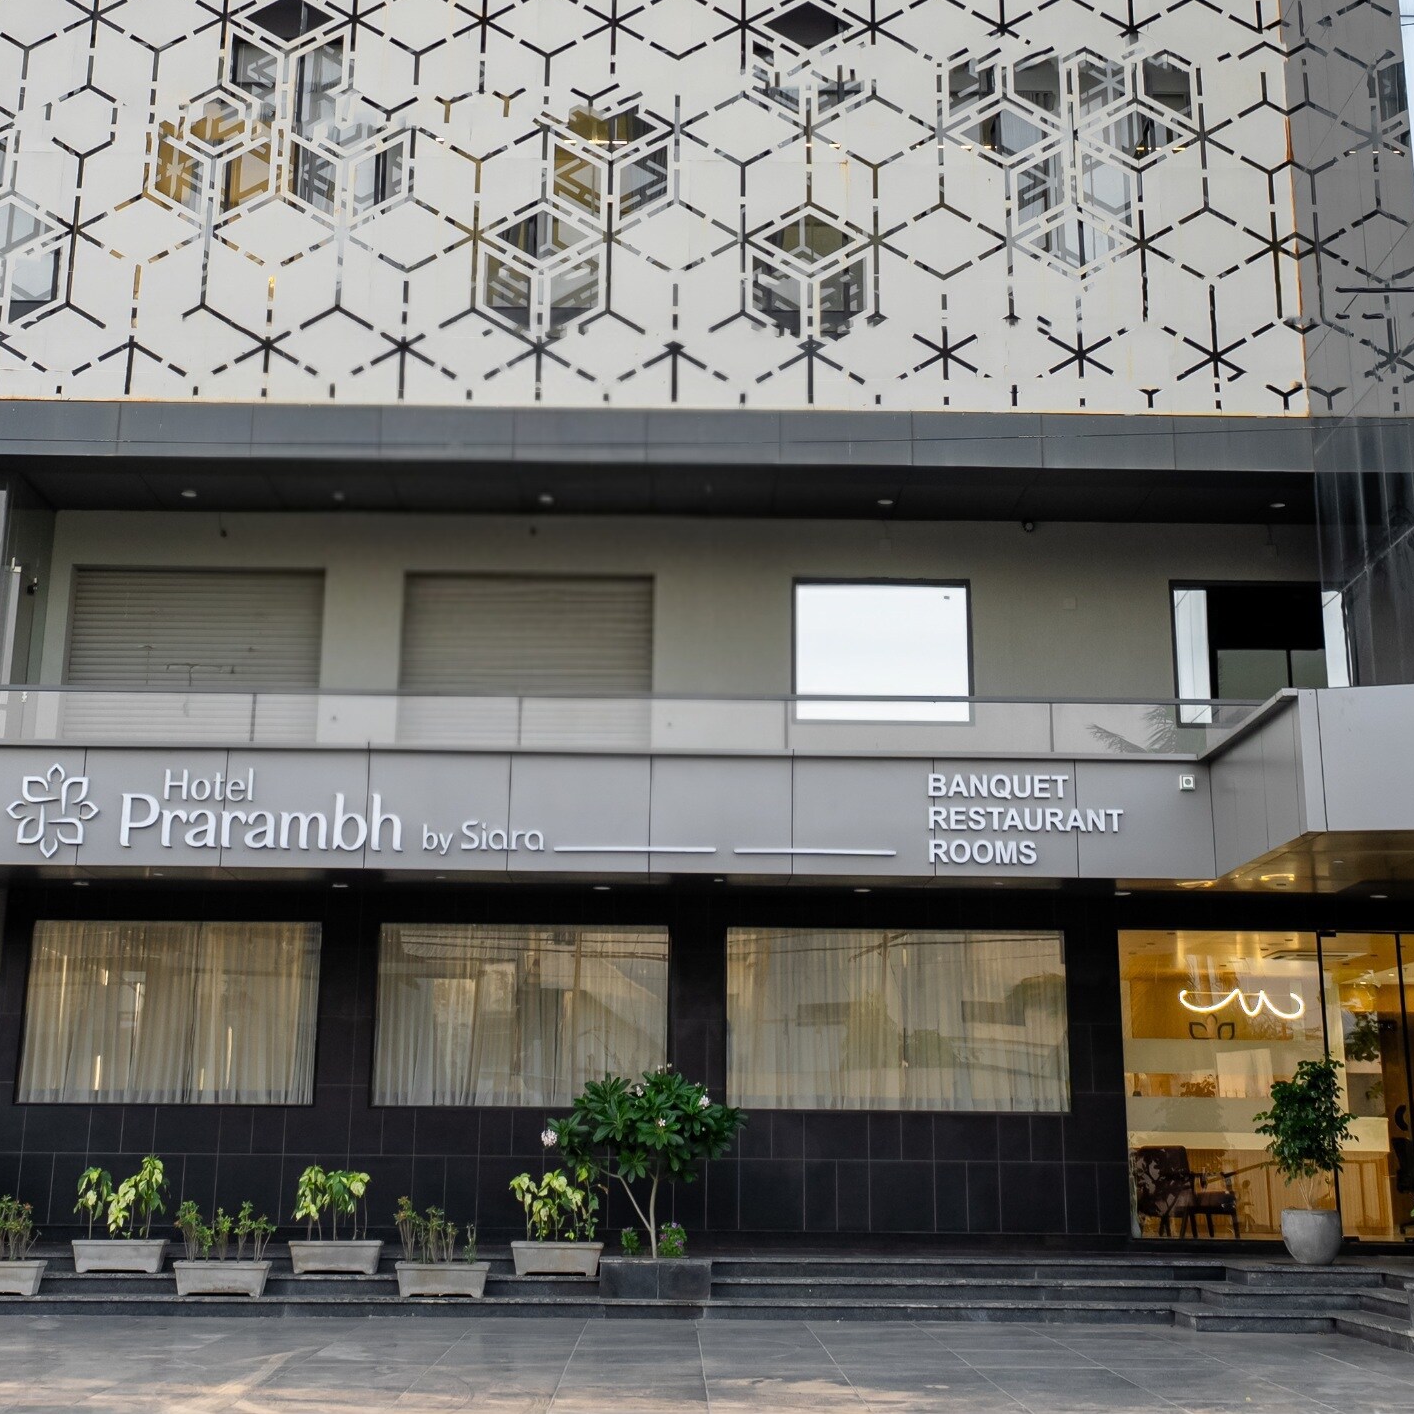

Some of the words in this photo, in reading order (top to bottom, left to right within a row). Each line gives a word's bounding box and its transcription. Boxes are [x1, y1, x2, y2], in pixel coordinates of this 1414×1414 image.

[163, 767, 255, 802] Hotel
[927, 773, 1069, 800] BANQUET
[119, 792, 404, 852] Prarambh
[422, 823, 454, 856] by
[460, 819, 546, 852] Siara
[927, 806, 1124, 833] RESTAURANT
[928, 839, 1038, 865] ROOMS
